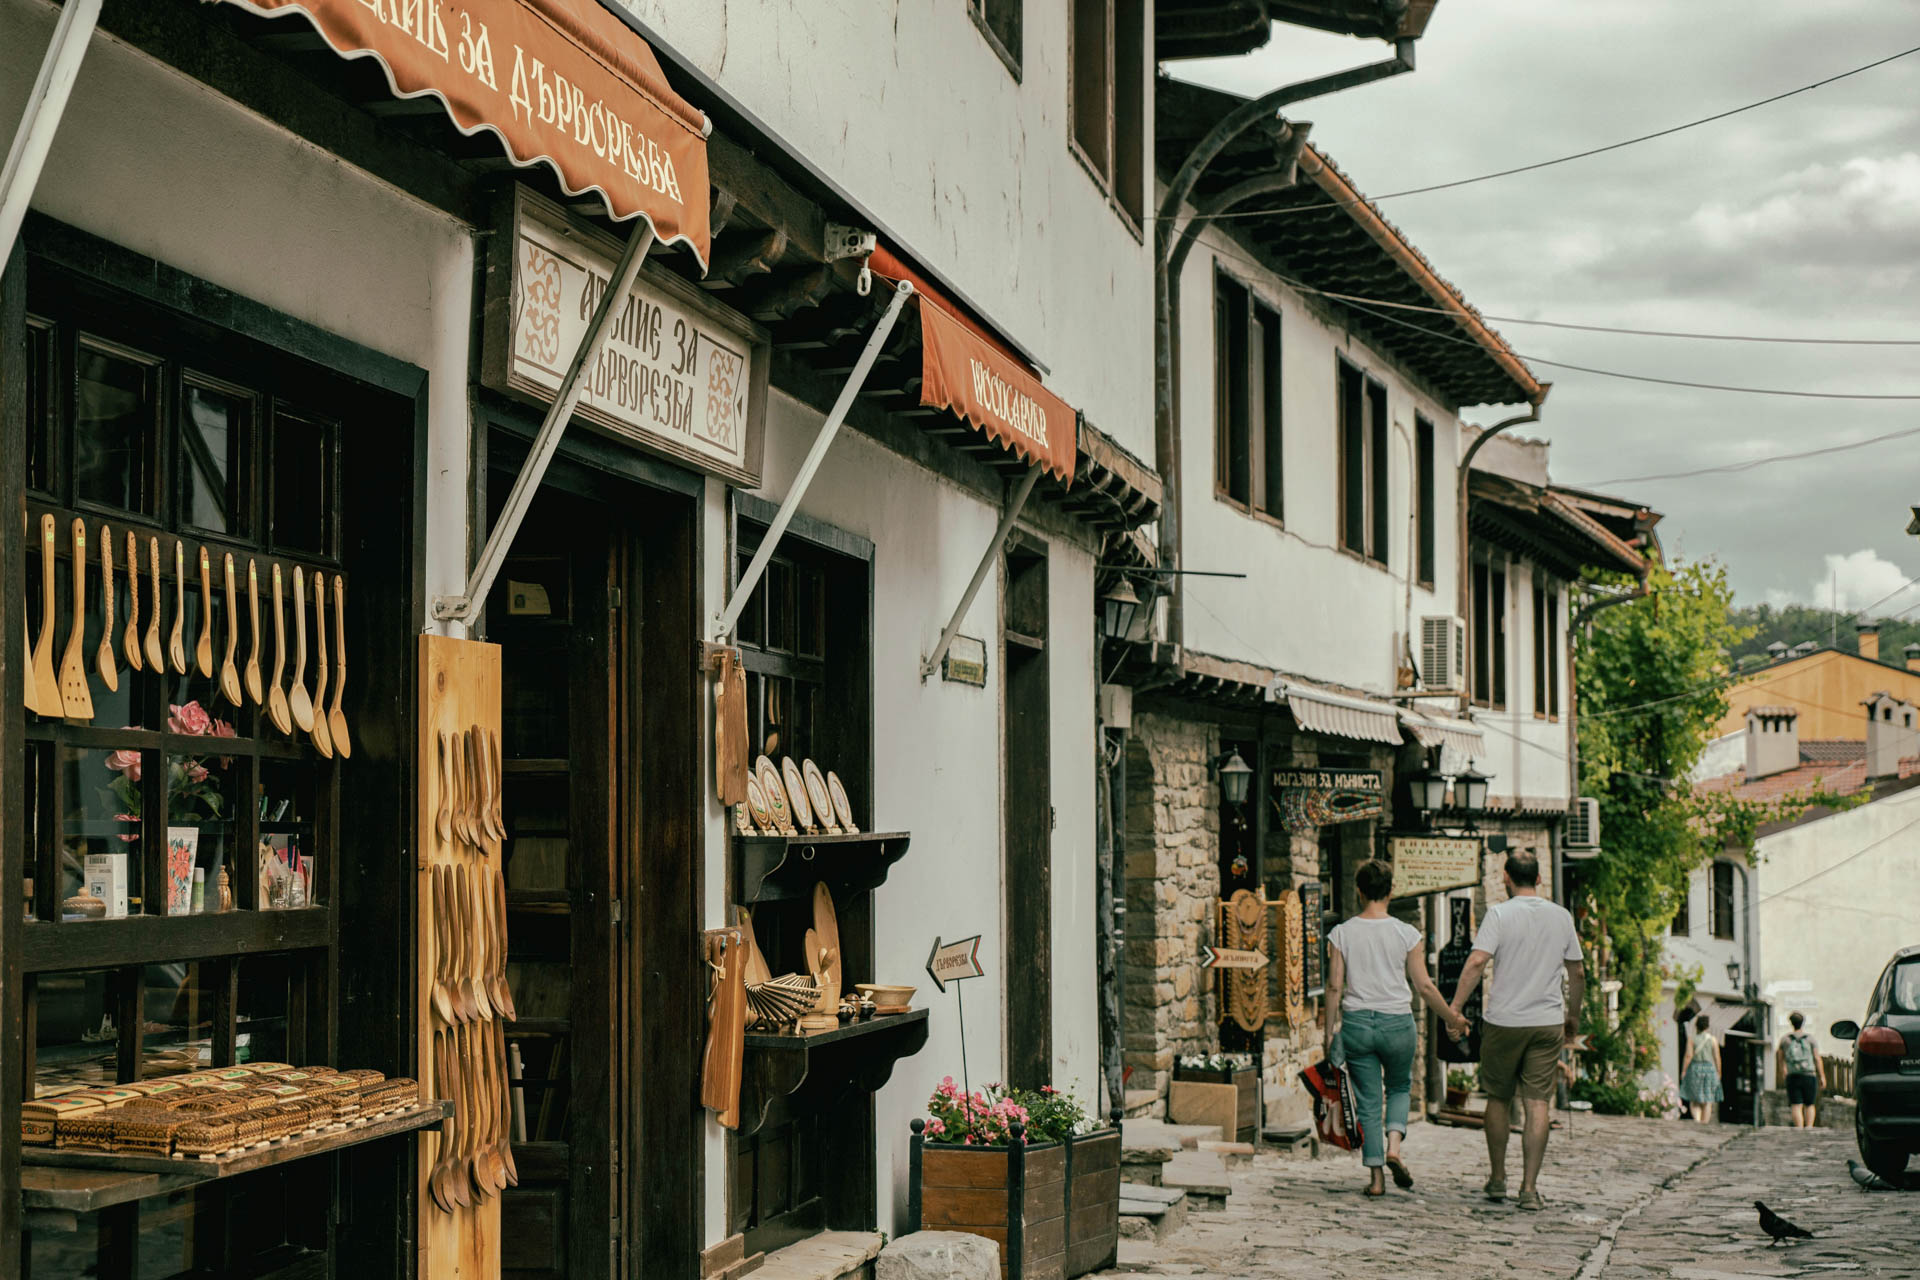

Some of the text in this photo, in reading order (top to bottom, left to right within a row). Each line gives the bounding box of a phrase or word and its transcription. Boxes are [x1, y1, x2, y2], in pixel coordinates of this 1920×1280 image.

[458, 9, 498, 92] ЗА
[509, 44, 684, 205] ДЪРВОРЕЗБА
[671, 318, 699, 377] ЗА
[1273, 771, 1381, 790] МАГАЗИН ЗА МЪНИСТА
